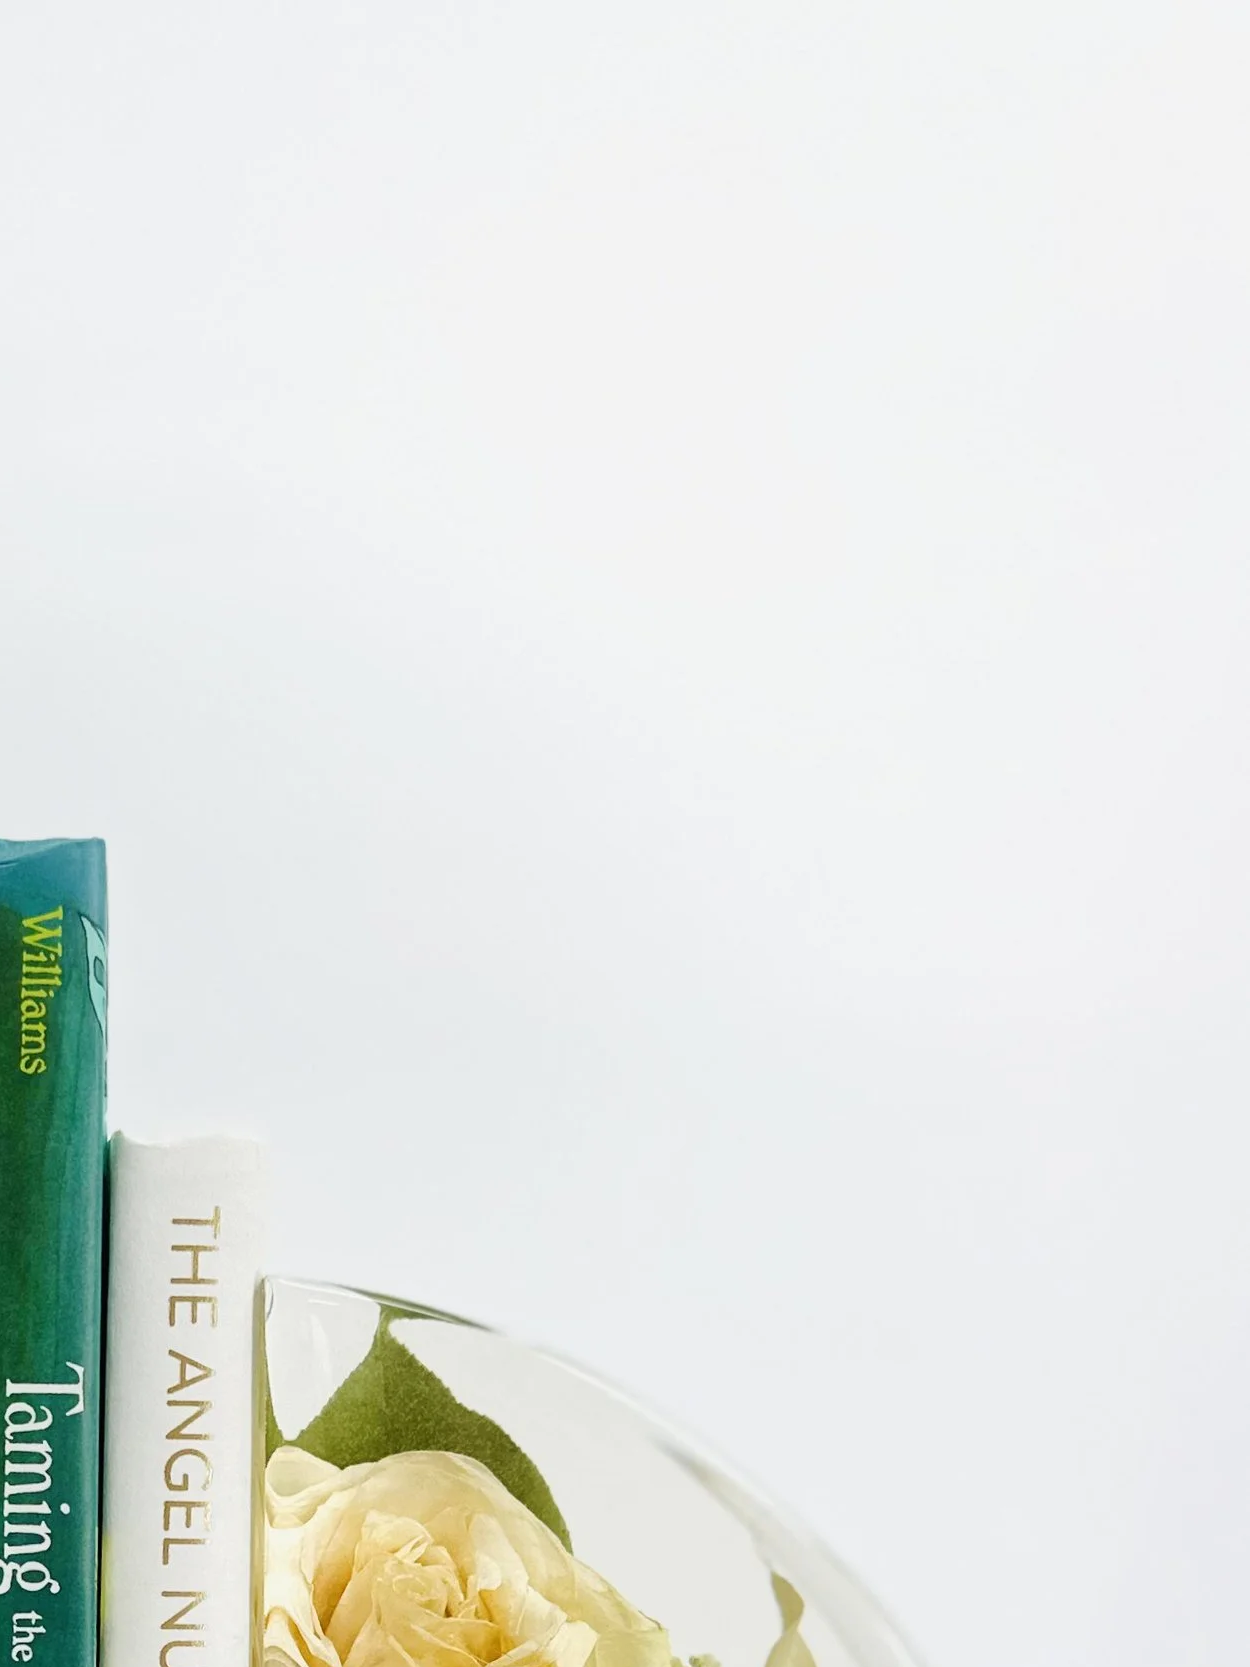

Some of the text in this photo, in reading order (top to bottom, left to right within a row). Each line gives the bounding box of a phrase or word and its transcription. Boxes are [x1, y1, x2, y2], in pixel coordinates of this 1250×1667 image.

[19, 905, 64, 1075] Williams
[168, 1206, 221, 1327] THE
[161, 1350, 215, 1565] ANGEL
[11, 1610, 46, 1662] the
